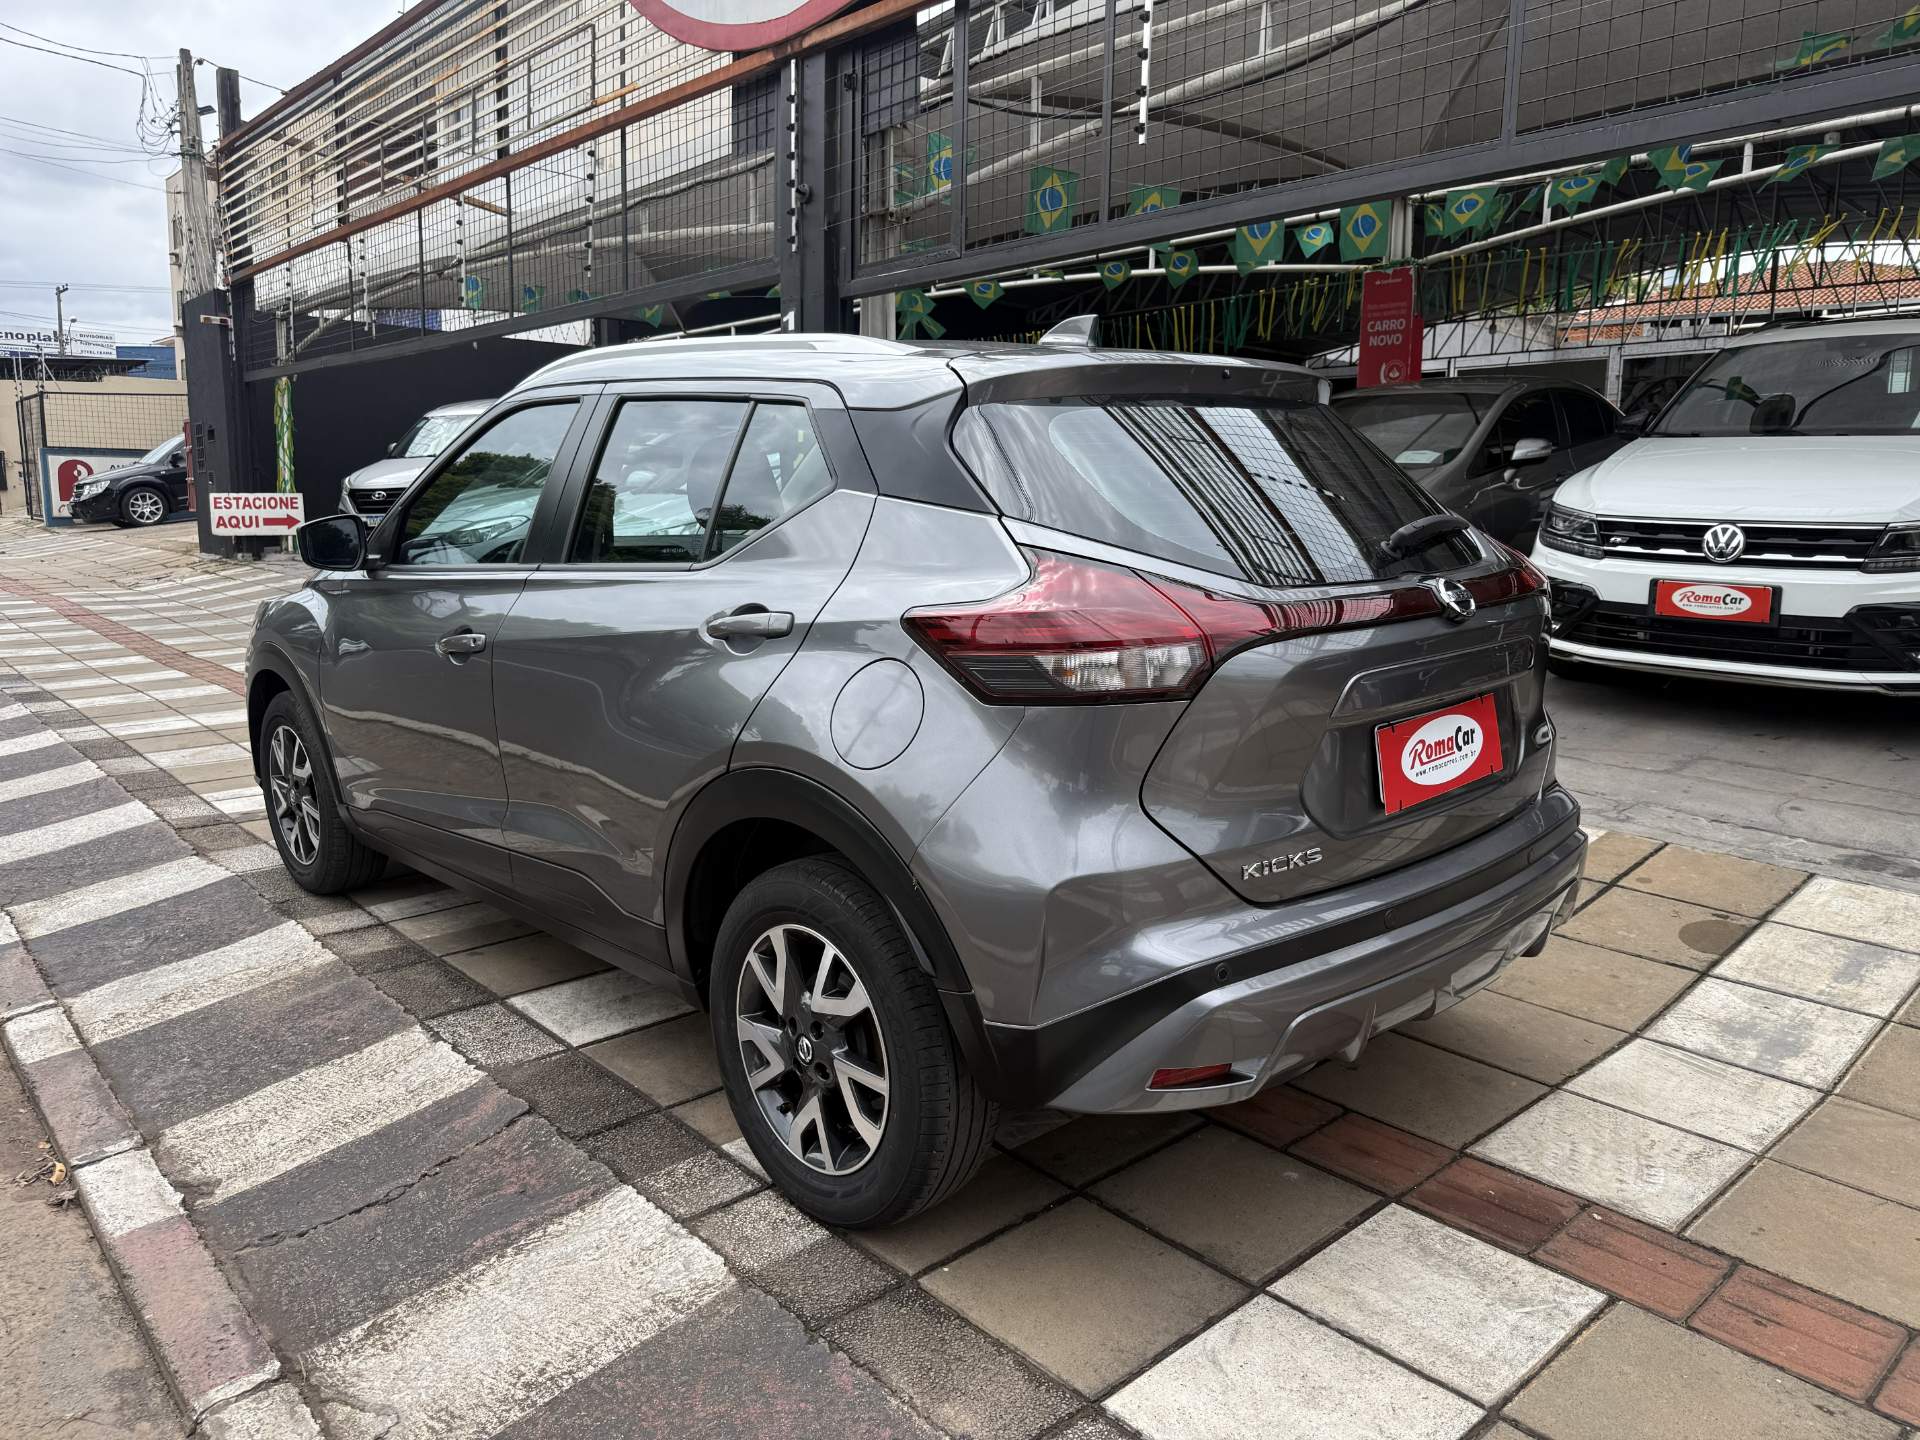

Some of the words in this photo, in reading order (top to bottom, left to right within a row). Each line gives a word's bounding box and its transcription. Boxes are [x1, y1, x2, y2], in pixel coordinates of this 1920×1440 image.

[1368, 319, 1406, 332] CARRO
[1369, 334, 1402, 347] NOVO
[213, 496, 299, 510] ESTACIONE
[216, 515, 260, 529] AQUI
[1679, 590, 1744, 605] RomaCar
[1408, 725, 1476, 770] RomaCar
[1241, 847, 1323, 880] KICKS
